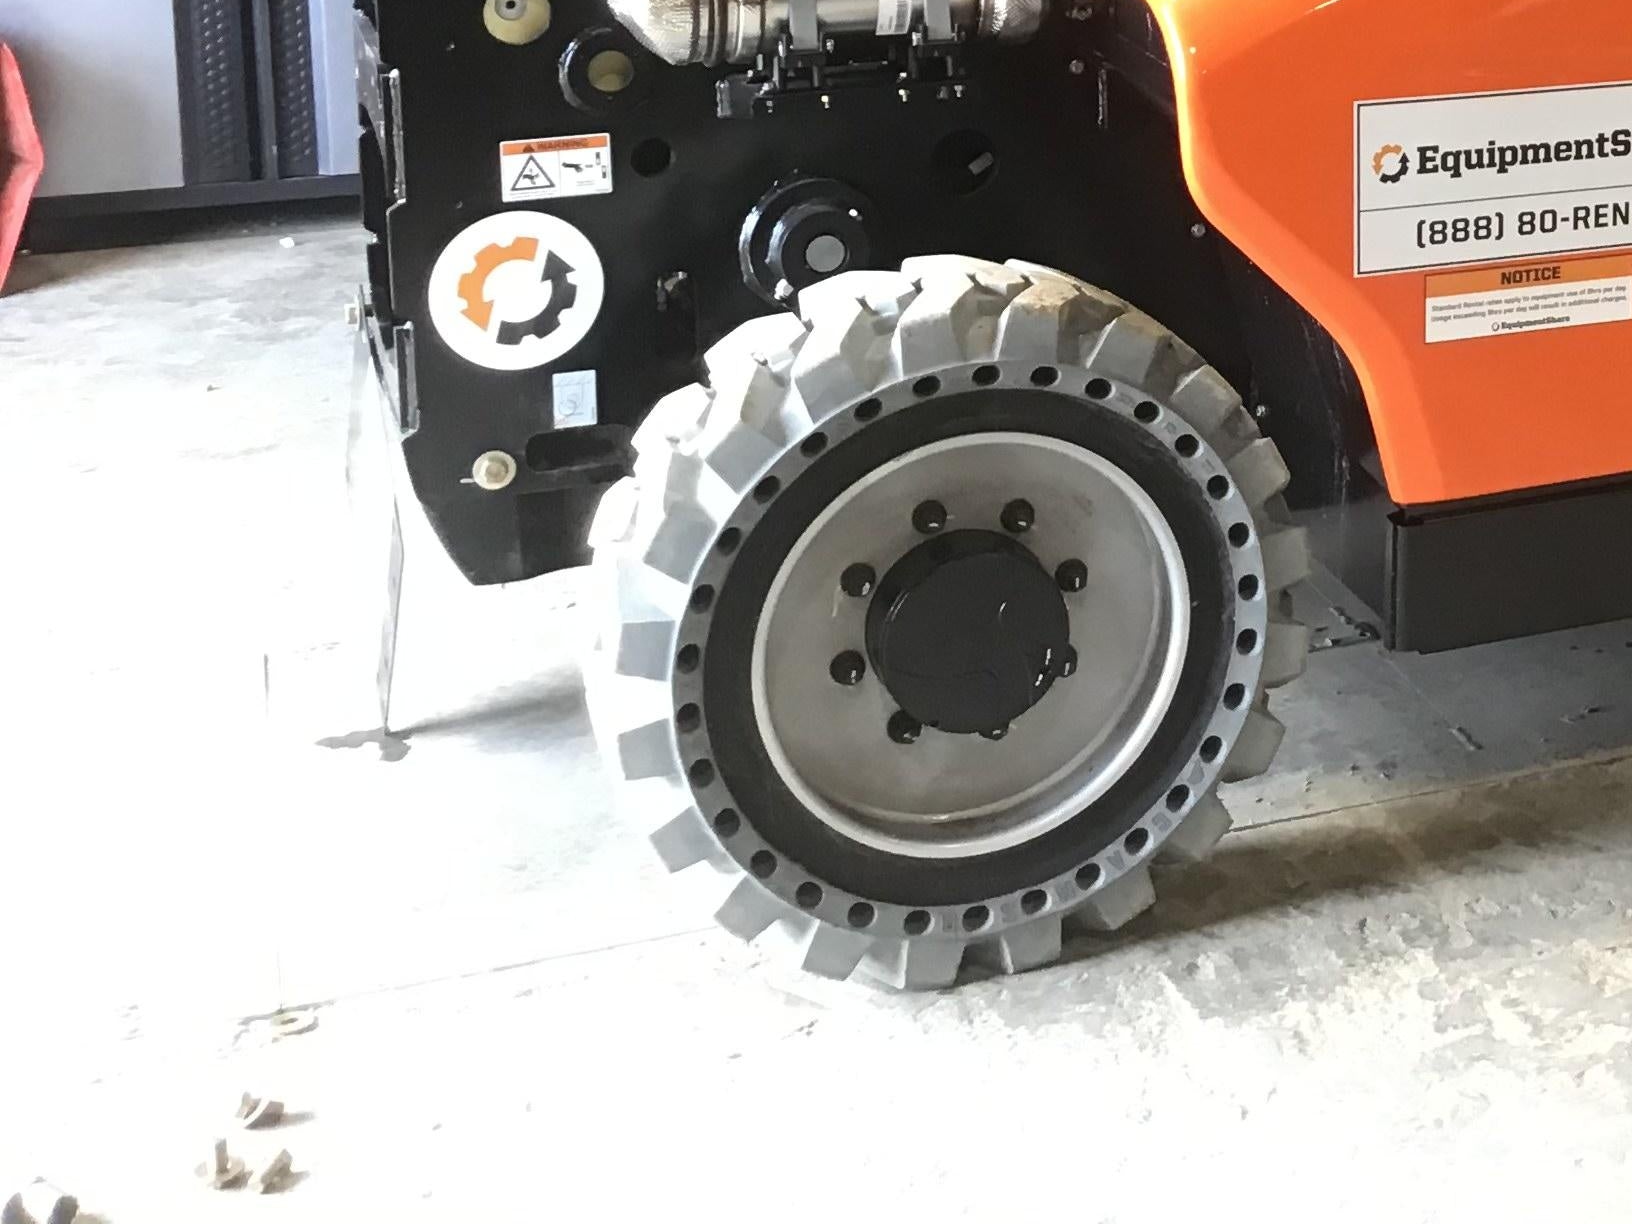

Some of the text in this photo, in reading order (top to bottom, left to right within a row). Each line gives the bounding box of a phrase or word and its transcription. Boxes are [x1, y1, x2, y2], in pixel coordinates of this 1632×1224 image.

[1416, 211, 1505, 249] (888)
[1500, 266, 1561, 285] NOTICE
[1501, 315, 1570, 330] EquipmentShare
